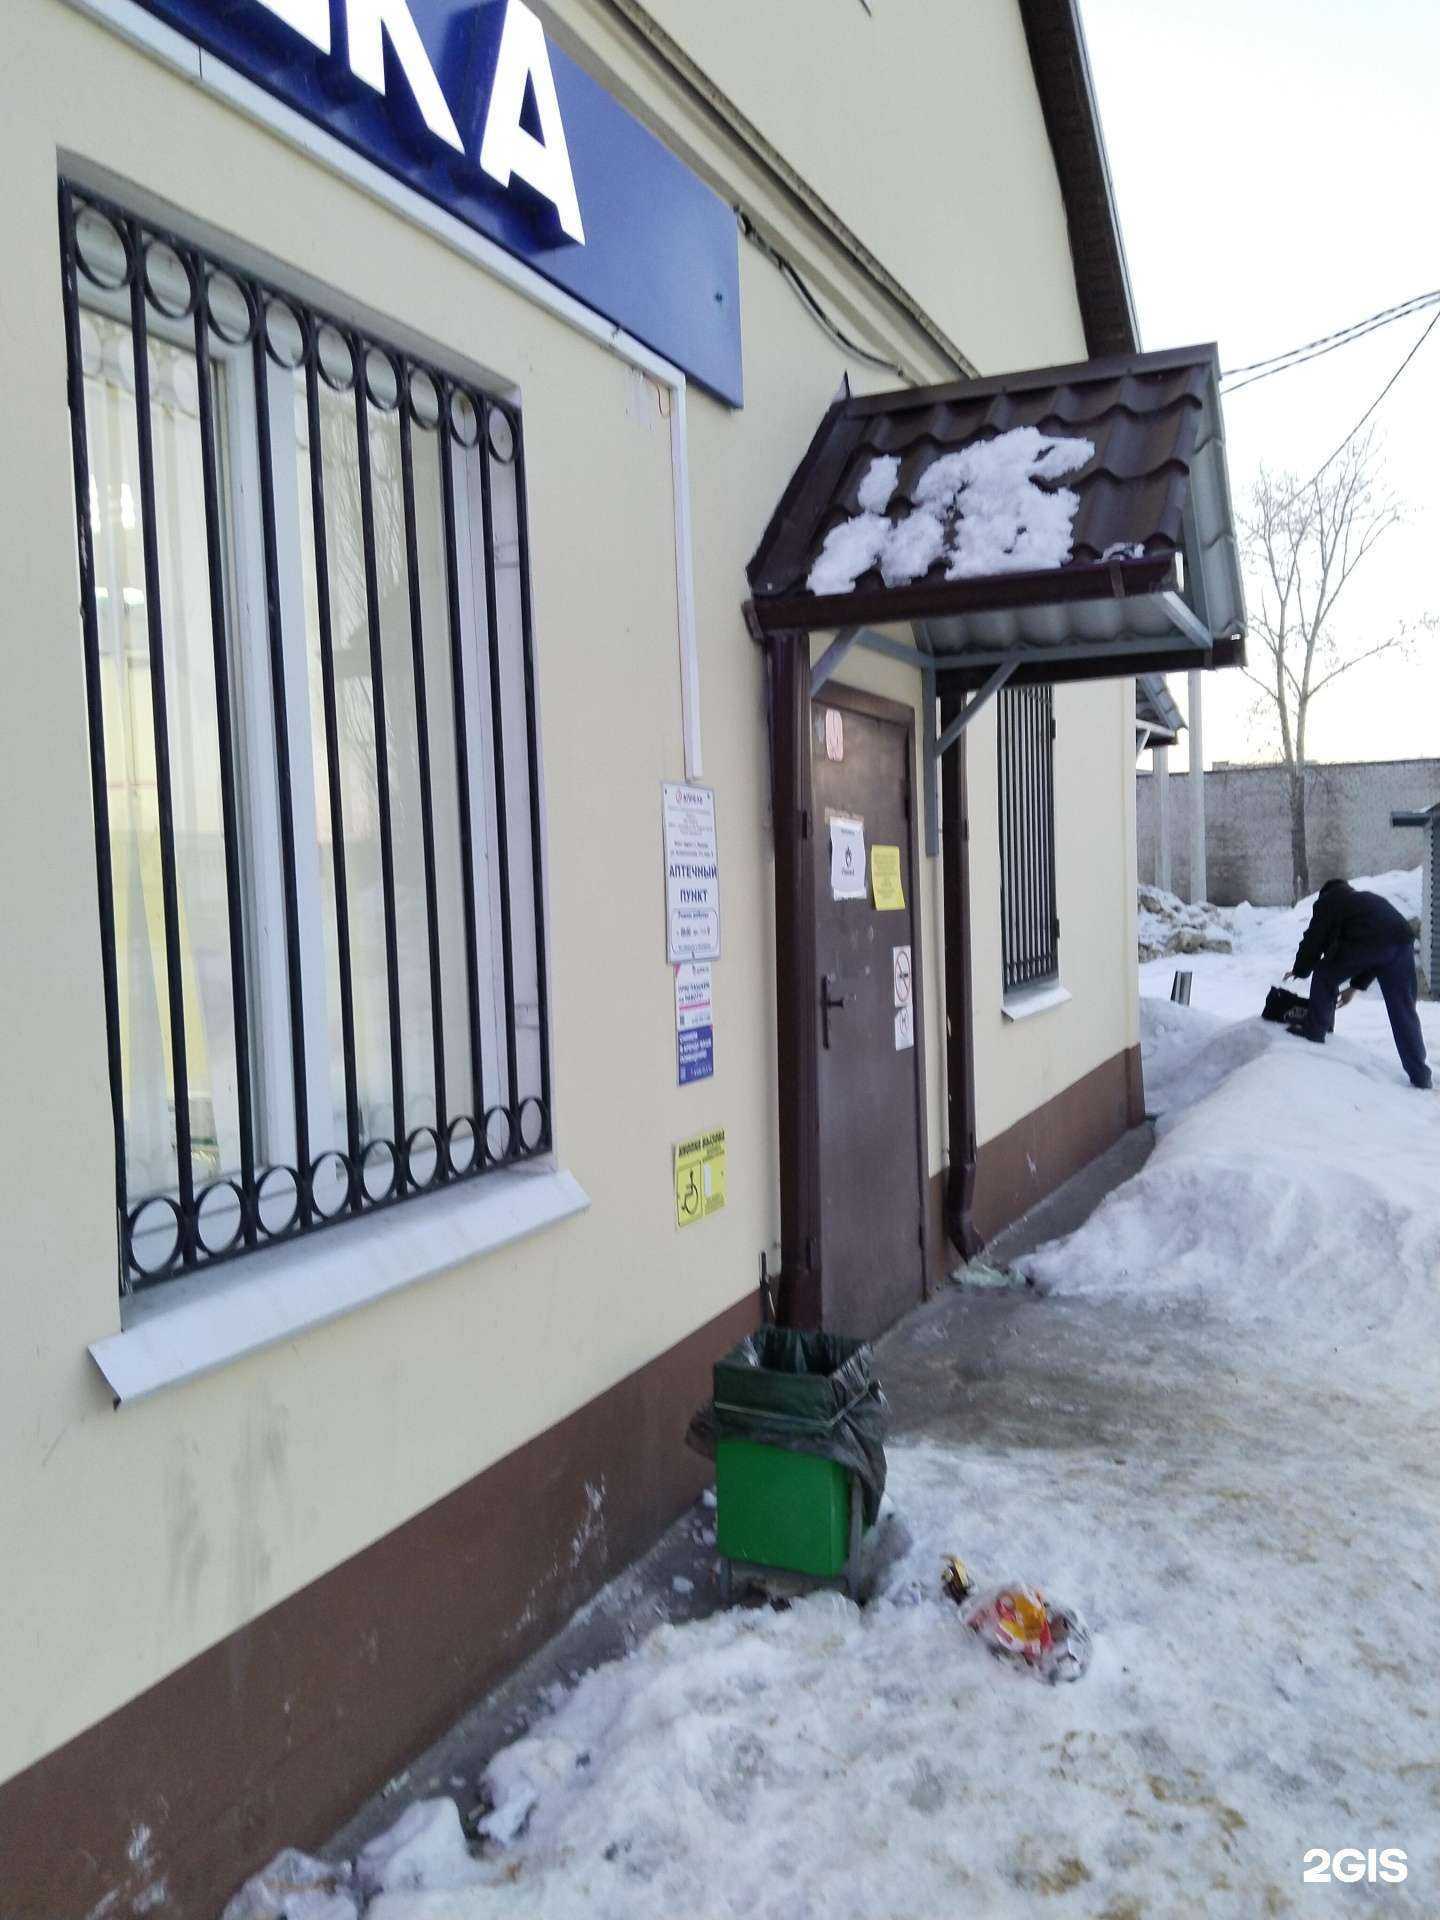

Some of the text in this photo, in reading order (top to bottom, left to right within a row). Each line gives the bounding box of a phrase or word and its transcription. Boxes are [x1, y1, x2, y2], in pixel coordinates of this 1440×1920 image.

[257, 0, 585, 246] КА
[669, 862, 718, 879] АПТЕЧНЫЙ
[680, 888, 708, 903] ПУНКТ
